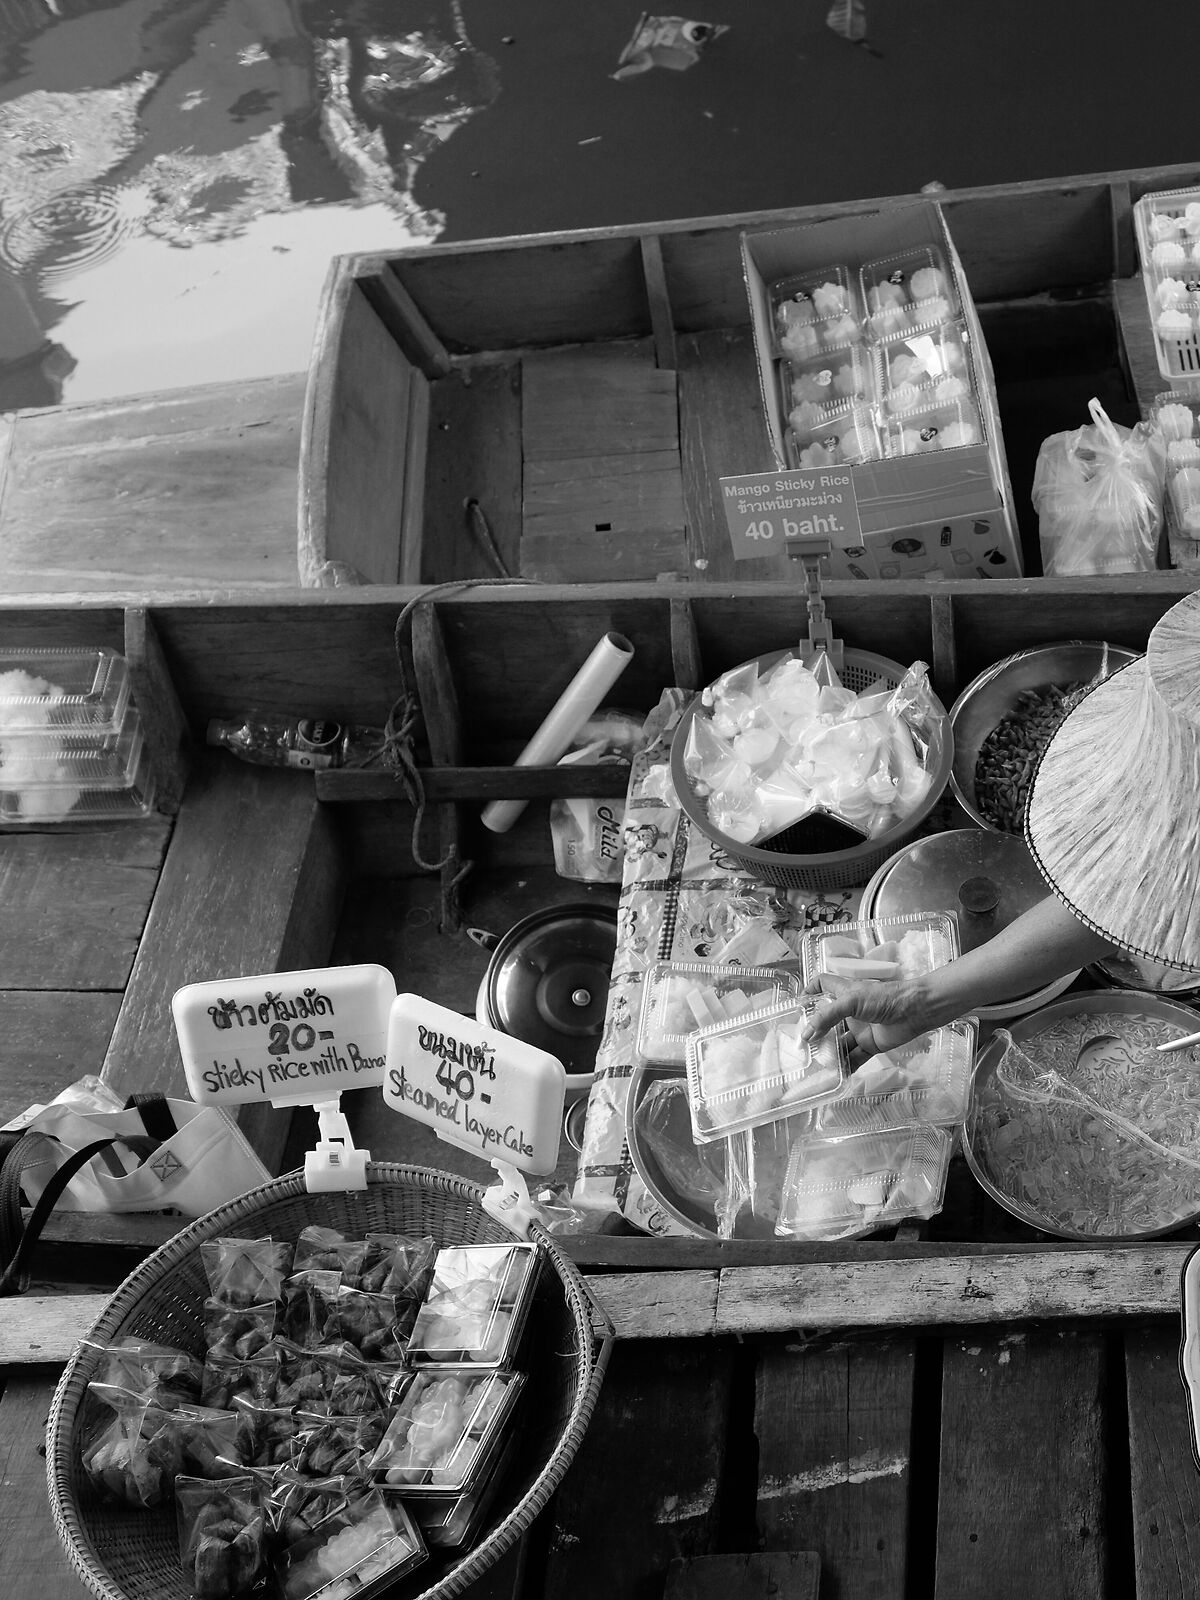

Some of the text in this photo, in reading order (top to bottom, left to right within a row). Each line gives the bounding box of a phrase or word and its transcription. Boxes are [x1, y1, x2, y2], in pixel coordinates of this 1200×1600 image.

[724, 475, 849, 497] Mango Sticky Rice
[745, 513, 845, 540] 40 baht.
[567, 839, 576, 856] 150
[597, 806, 621, 860] Mild
[207, 987, 335, 1031] ข้าวต้มมัด
[309, 1045, 348, 1075] with
[346, 1043, 387, 1073] Bana
[389, 1065, 534, 1157] Steamed layer Cake
